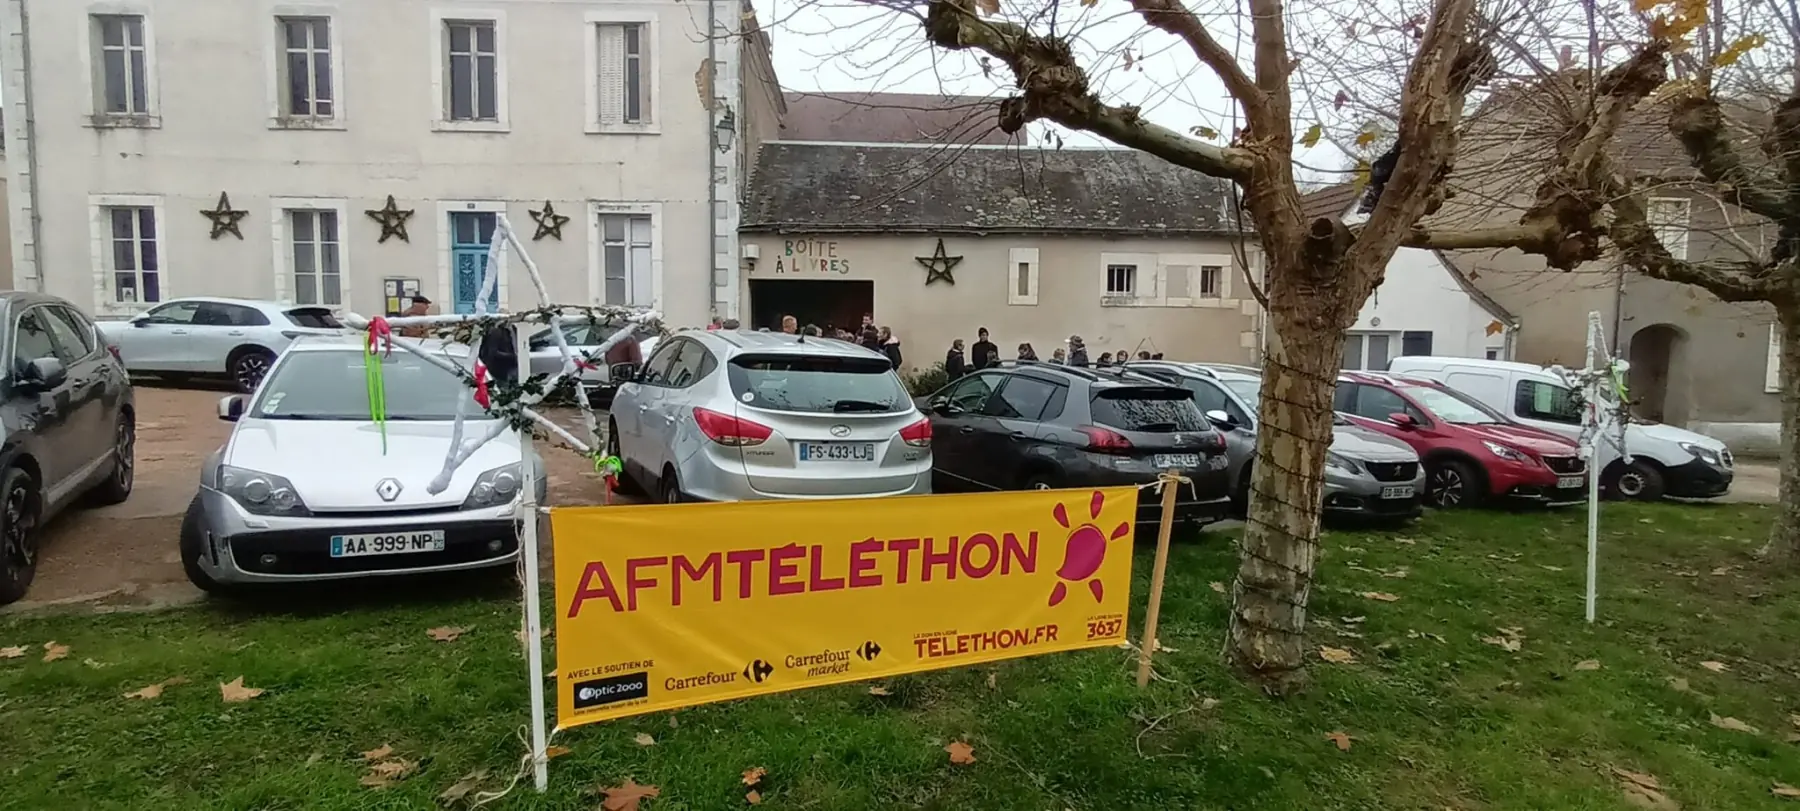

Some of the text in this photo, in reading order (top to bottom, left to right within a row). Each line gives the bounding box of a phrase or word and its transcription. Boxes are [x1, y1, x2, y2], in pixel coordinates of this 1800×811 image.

[785, 238, 838, 258] BOÎTE
[808, 444, 867, 460] FS-433-LJ
[345, 533, 433, 554] AA-999-NP
[567, 531, 1038, 619] AFMTÉLÉTHON
[1087, 619, 1122, 638] 3637
[785, 649, 850, 668] Carrefour
[567, 660, 654, 680] AVEC LE SOUTIEN DE
[807, 662, 849, 677] market
[664, 671, 737, 691] Carrefour
[579, 682, 643, 700] Optic 2000
